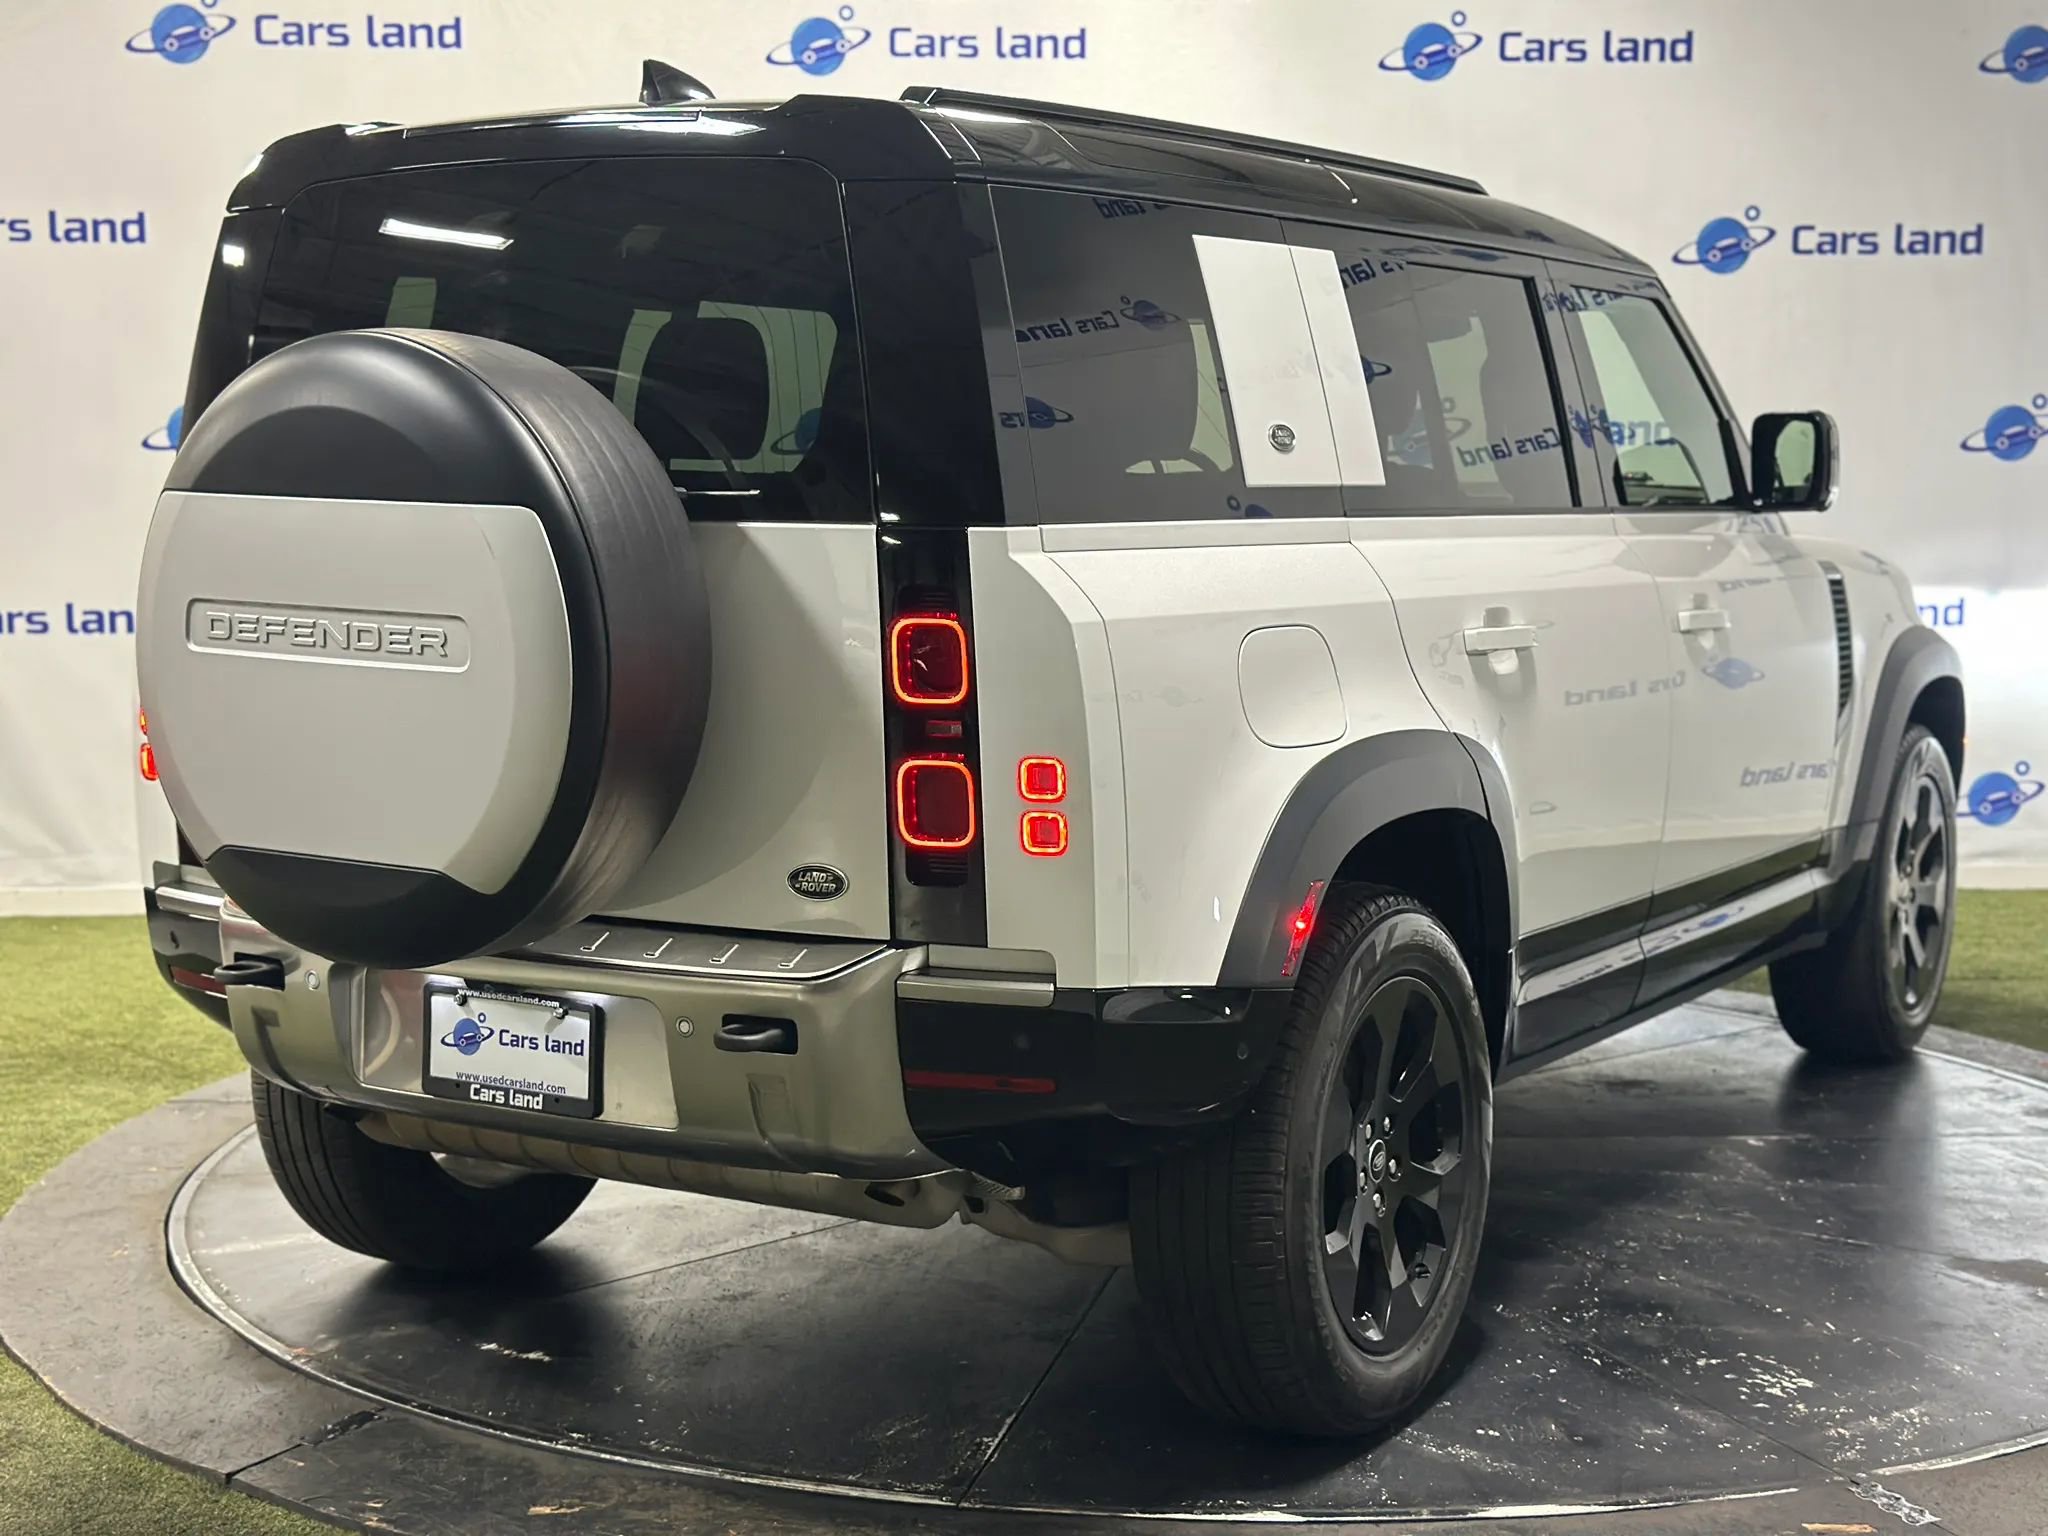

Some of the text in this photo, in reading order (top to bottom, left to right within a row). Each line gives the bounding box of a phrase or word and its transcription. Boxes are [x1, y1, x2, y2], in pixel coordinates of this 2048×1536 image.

[254, 14, 462, 49] Cars land
[889, 26, 1086, 59] Cars land
[1499, 29, 1693, 62] Cars land
[48, 209, 146, 243] land
[1792, 223, 1983, 255] Cars land
[65, 602, 135, 634] lan
[1918, 598, 1965, 626] nd
[205, 610, 449, 658] DEFENDER
[798, 871, 827, 882] LAND
[801, 882, 836, 892] ROVER
[457, 987, 560, 1007] www.usedcarsland.com
[499, 1029, 584, 1056] Cars land
[456, 1071, 566, 1094] www.usedcarsland.com
[470, 1084, 543, 1110] Cars land
